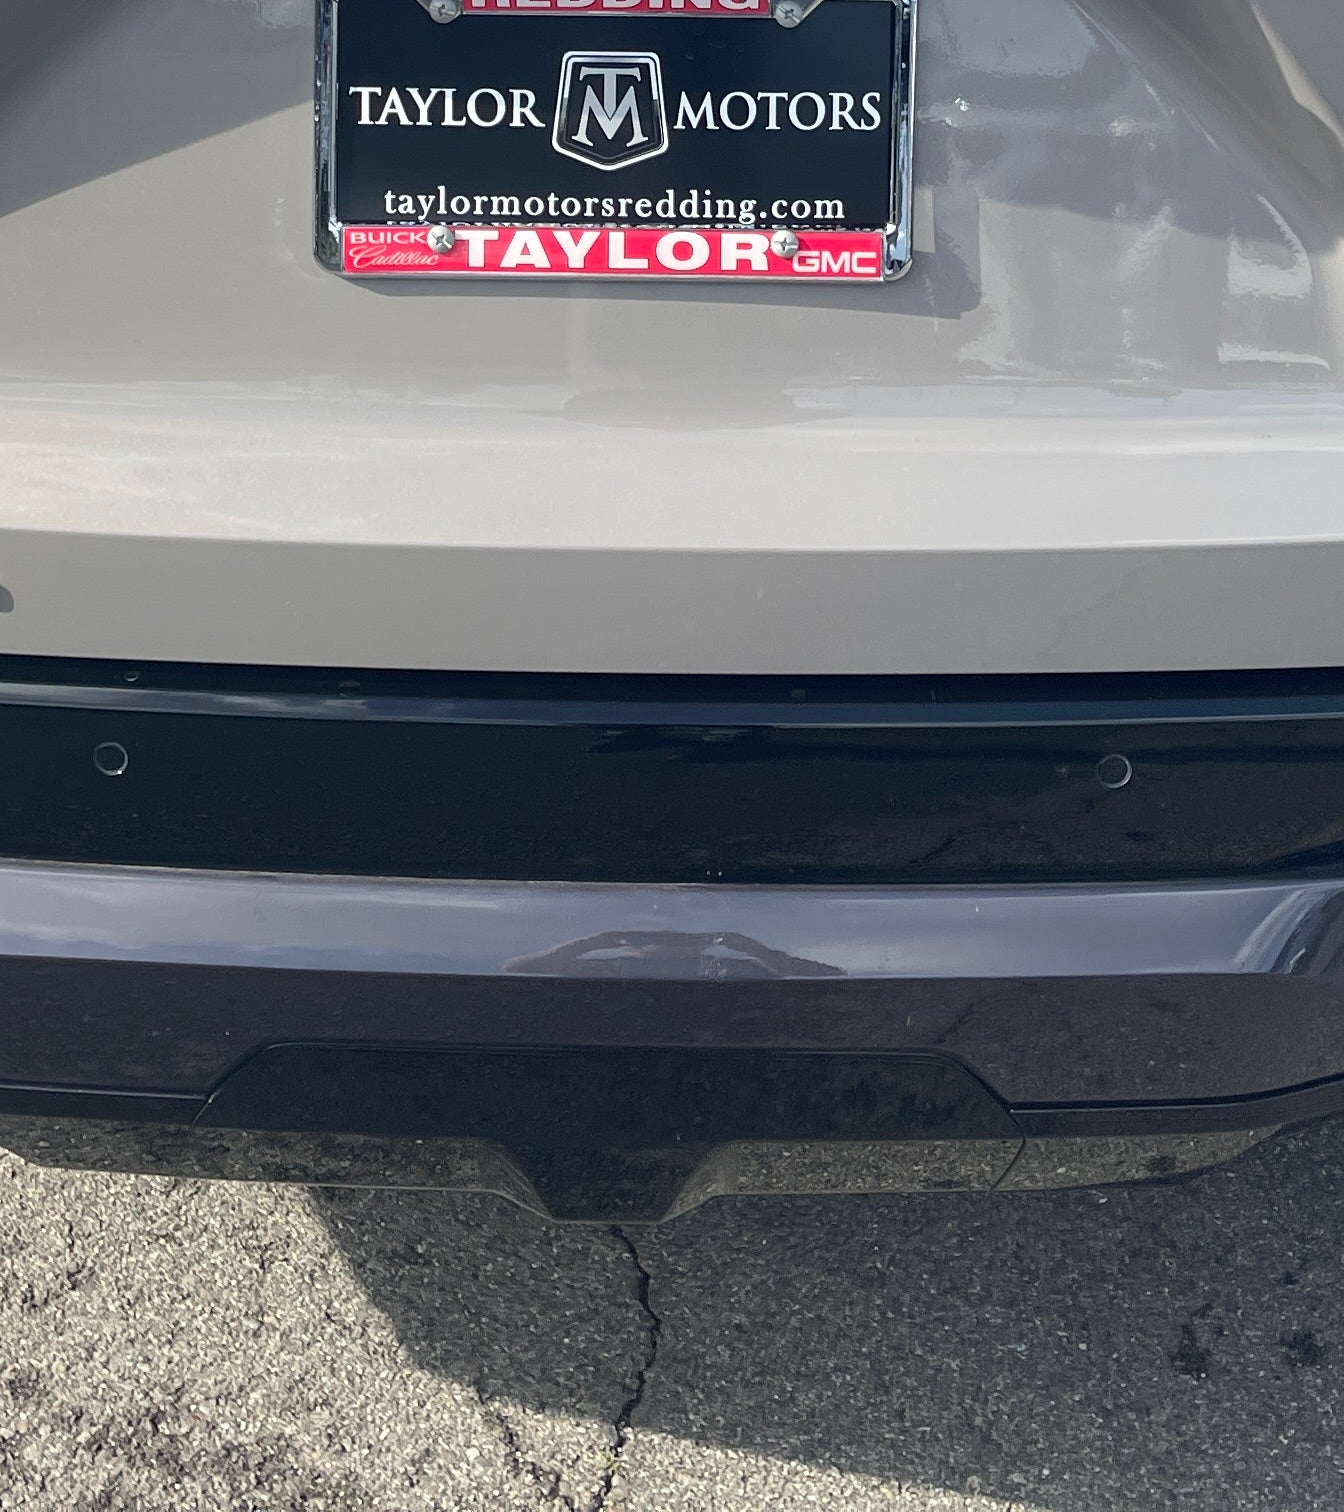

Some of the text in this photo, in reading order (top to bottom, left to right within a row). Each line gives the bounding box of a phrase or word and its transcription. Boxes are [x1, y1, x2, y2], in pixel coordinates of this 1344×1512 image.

[348, 86, 882, 131] TAYLOR MOTORS
[384, 185, 845, 225] taylormotorsredding.com
[349, 231, 428, 245] BUICK
[454, 230, 771, 272] TAYLOR
[349, 245, 440, 269] Cadillac
[792, 250, 877, 274] GMC
